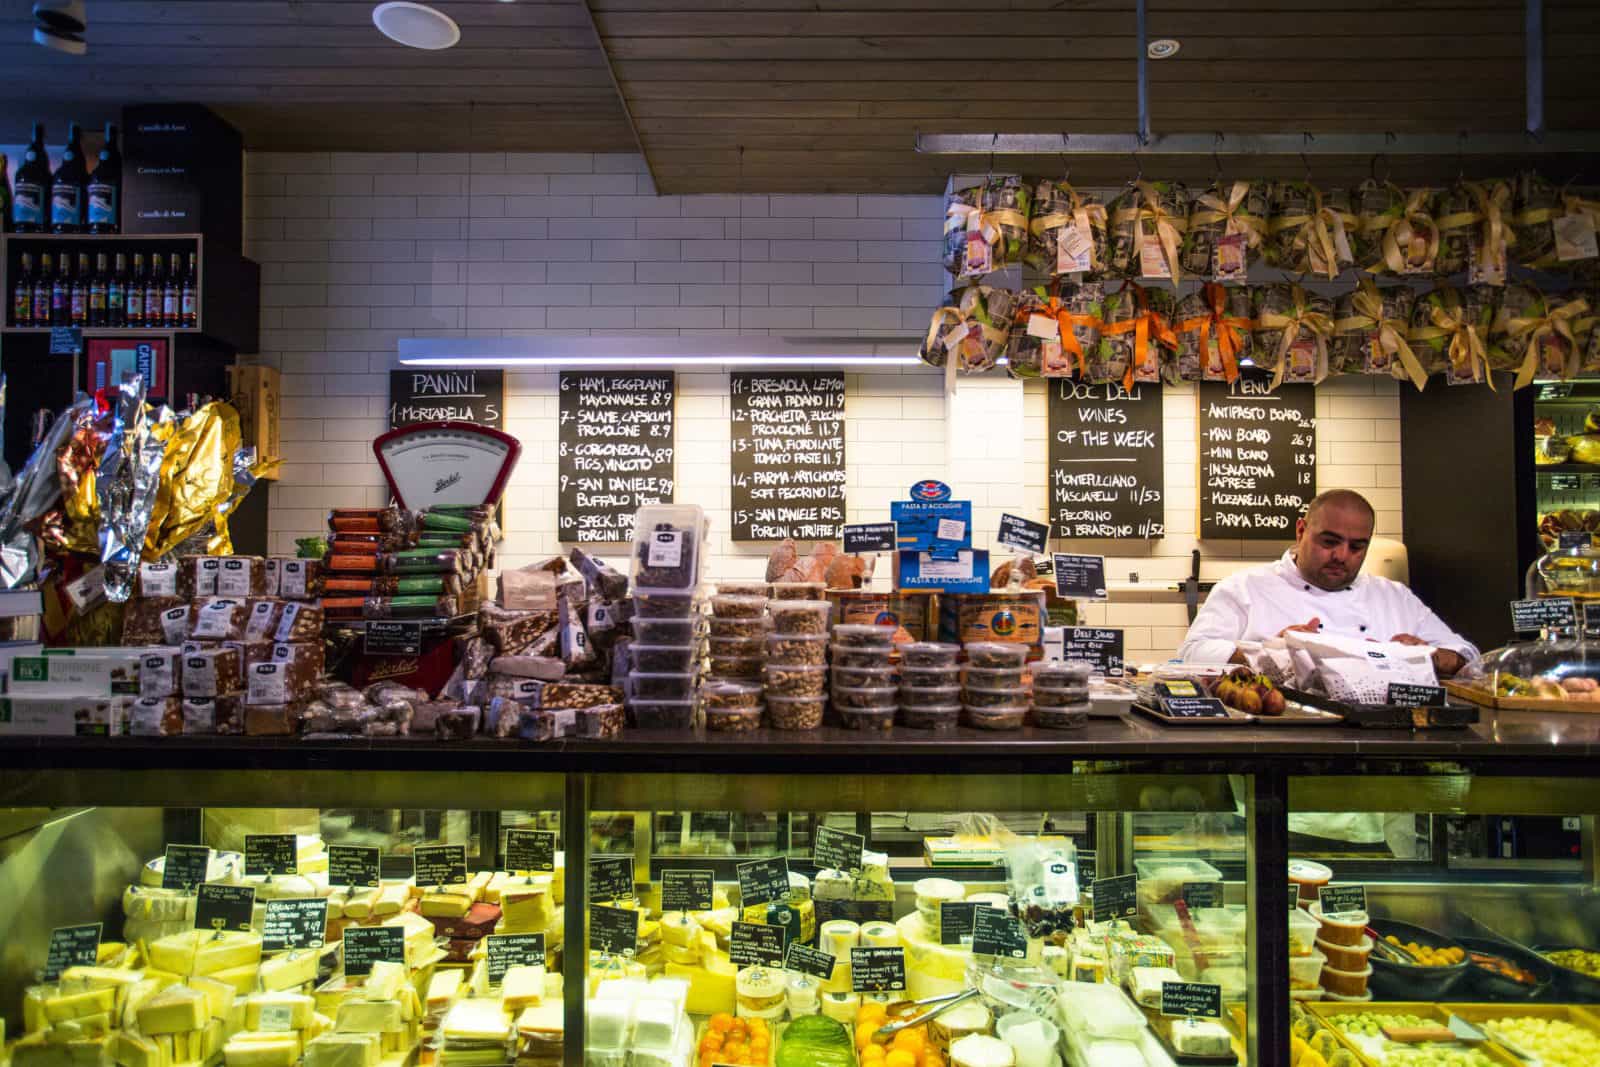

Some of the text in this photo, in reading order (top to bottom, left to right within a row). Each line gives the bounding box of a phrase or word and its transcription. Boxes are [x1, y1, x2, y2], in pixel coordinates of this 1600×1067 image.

[612, 379, 670, 391] EGGPLANT
[580, 394, 648, 408] MAYONNAISE
[747, 395, 783, 409] GRANA
[784, 394, 823, 408] PADANO
[402, 406, 474, 421] MORTADELLA
[484, 404, 499, 421] 5
[1078, 407, 1128, 424] WINES
[1208, 402, 1302, 422] ANTIPASTO BOARD
[577, 424, 640, 437] PROVOLONE
[751, 423, 813, 436] PROVOLONE
[1236, 427, 1271, 444] BOARD
[1057, 430, 1156, 448] OF THE WEEK
[753, 452, 791, 465] TOMATO
[793, 452, 822, 464] PASTE
[1210, 446, 1233, 459] MINI
[1237, 447, 1269, 461] BOARD
[578, 478, 603, 492] SAN
[608, 477, 658, 491] DANIELE
[1207, 477, 1257, 490] CAPRESE
[1298, 471, 1311, 486] 18
[577, 492, 631, 508] BUFFALO
[751, 488, 775, 500] SOFT
[777, 487, 826, 500] PECORINO
[1212, 491, 1303, 507] MOZZARELLA BOARD
[754, 507, 776, 522] SAN
[777, 507, 818, 521] DANIELE
[1060, 508, 1112, 522] PECORINO
[1215, 511, 1289, 529] PARMA BOARD
[578, 529, 620, 542] PORCINI
[750, 524, 790, 538] PORCINI
